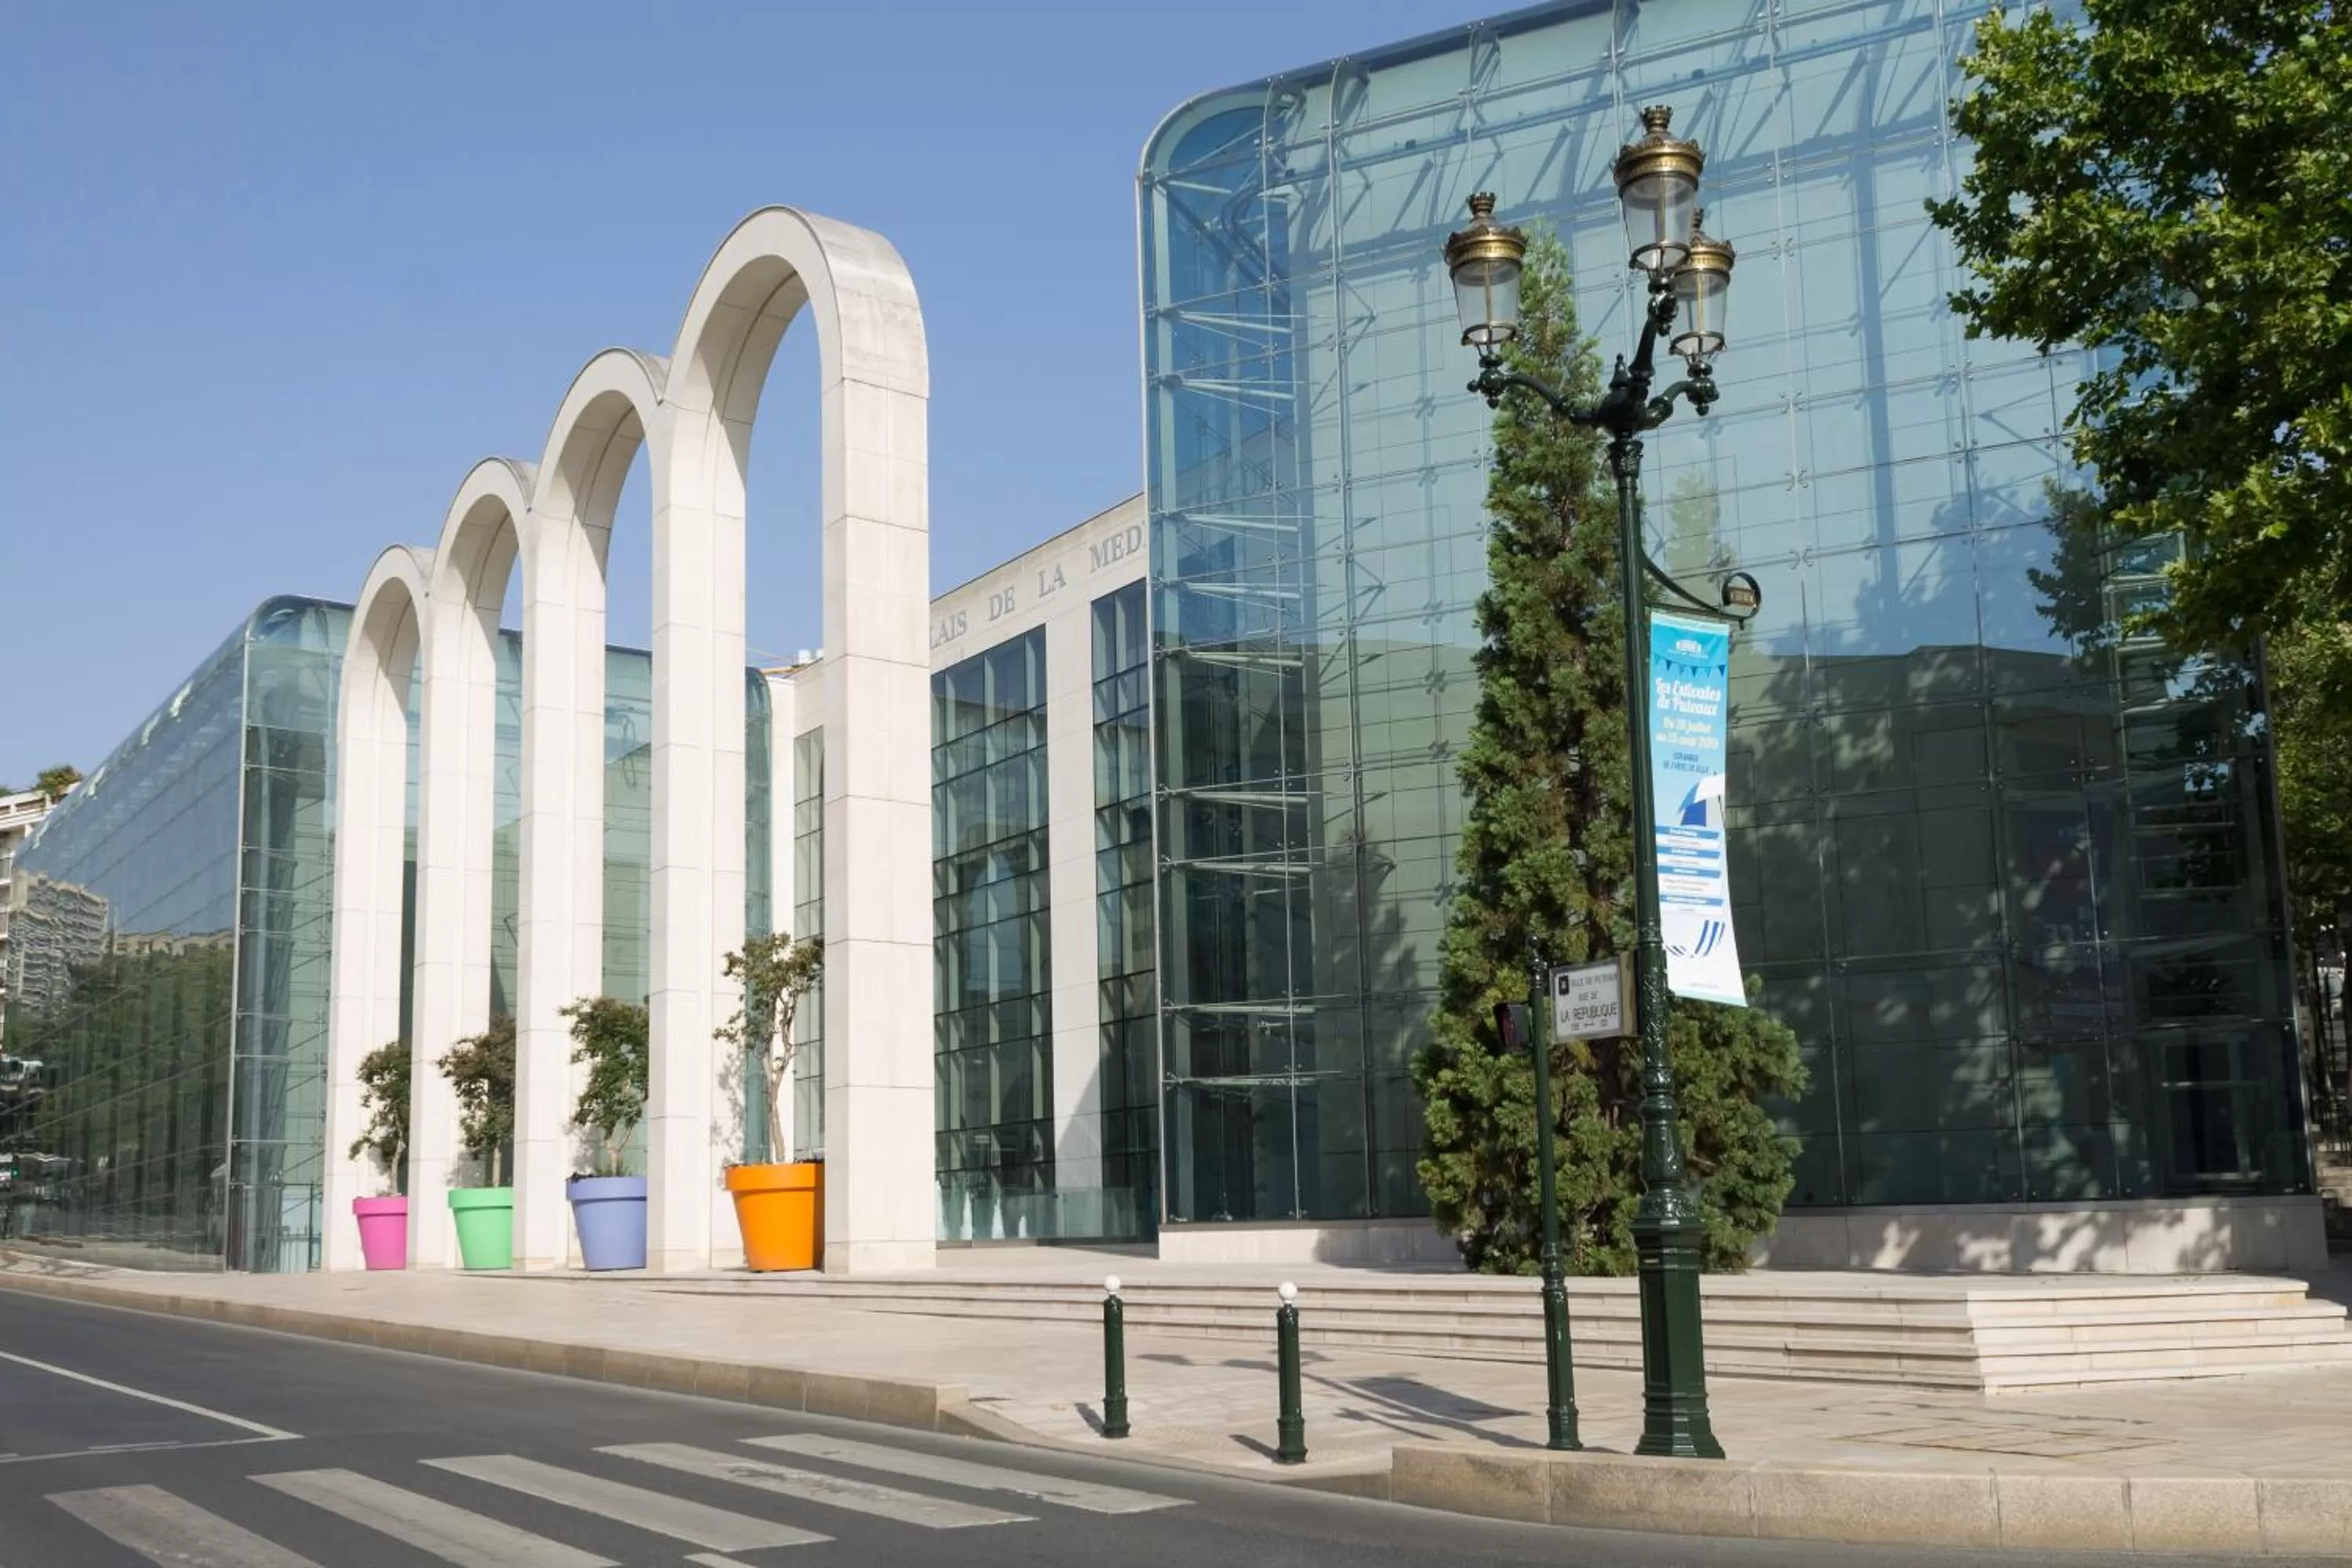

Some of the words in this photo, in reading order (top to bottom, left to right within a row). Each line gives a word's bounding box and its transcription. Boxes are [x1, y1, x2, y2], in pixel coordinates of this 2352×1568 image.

[989, 586, 1015, 622] DE
[1037, 563, 1067, 598] LA
[1090, 521, 1145, 574] MED
[1561, 1010, 1570, 1022] LA
